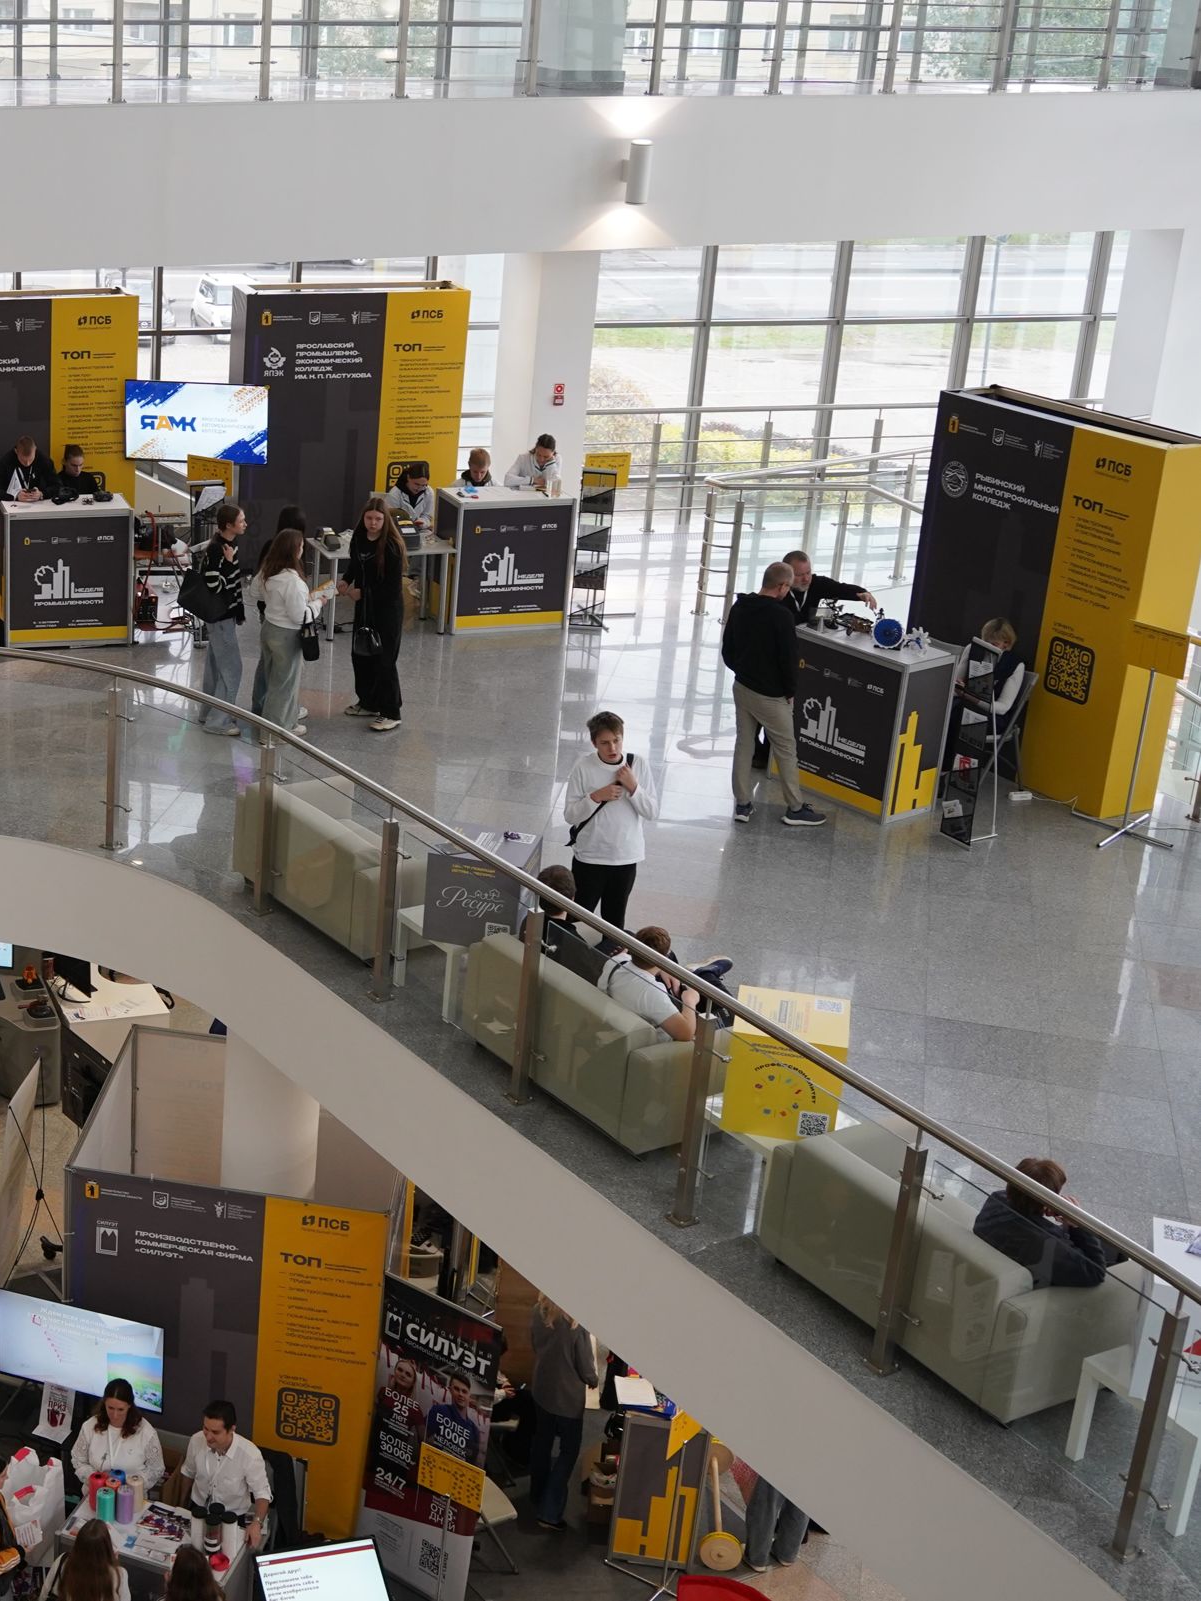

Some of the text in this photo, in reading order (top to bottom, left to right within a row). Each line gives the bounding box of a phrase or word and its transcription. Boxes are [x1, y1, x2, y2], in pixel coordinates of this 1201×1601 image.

[89, 315, 112, 325] ПСБ
[422, 309, 444, 319] ПСБ
[61, 350, 91, 360] ТОП
[296, 349, 360, 357] ПРОМЫШЛЕННО-
[393, 343, 422, 352] ТОП
[295, 356, 363, 364] ЭКОНОМИЧЕСКИЙ
[1108, 459, 1132, 477] ПСБ
[975, 472, 1025, 493] РЫБИНСКИЙ
[972, 493, 1011, 510] КОЛЛЕДЖ
[974, 483, 1060, 514] МНОГОПРОФИЛЬНЫЙ
[1073, 495, 1103, 514] ТОП
[479, 585, 544, 593] ПРОМЫШЛЕННОСТИ
[799, 736, 865, 765] ПРОМЫШЛЕННОСТИ
[838, 736, 867, 751] НЕДЕЛЯ
[436, 885, 504, 918] Ресурс
[96, 1219, 119, 1229] СИЛУЭТ
[318, 1217, 350, 1232] ПСБ
[135, 1230, 239, 1251] ПРОИЗВОДСТВЕННО-
[135, 1239, 254, 1263] КОММЕРЧЕСКАЯ ФИРМА
[135, 1249, 184, 1260] «СИЛУЭТ»
[279, 1251, 322, 1269] ТОП
[405, 1323, 492, 1376] СИЛУЭТ
[385, 1387, 420, 1411] БОЛЕЕ
[392, 1412, 408, 1424] лет
[393, 1402, 410, 1417] 25
[436, 1412, 471, 1440] БОЛЕЕ
[379, 1431, 414, 1456] БОЛЕЕ
[439, 1425, 466, 1449] 1000
[375, 1467, 407, 1490] 24/7
[430, 1503, 445, 1516] ОТ
[429, 1511, 456, 1532] ДНЙ
